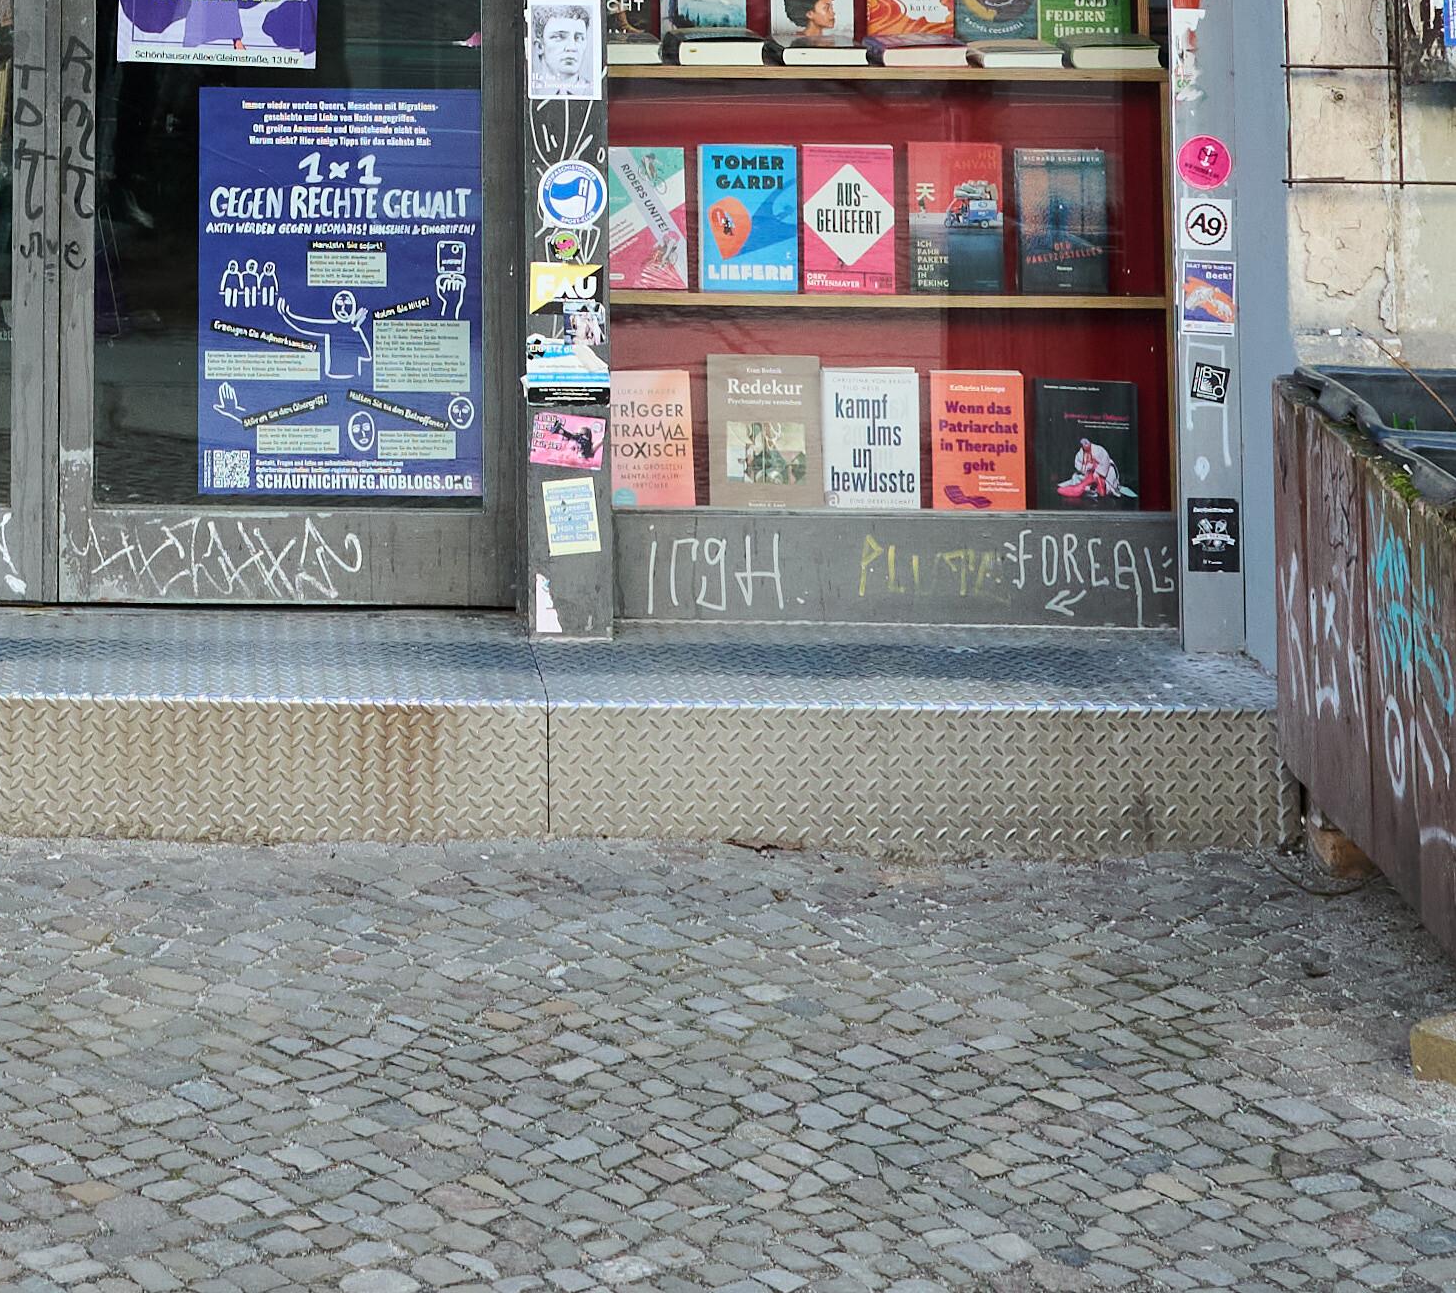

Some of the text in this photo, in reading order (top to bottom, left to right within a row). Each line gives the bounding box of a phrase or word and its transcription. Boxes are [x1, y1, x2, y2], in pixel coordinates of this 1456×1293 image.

[711, 155, 784, 170] TOMER
[716, 173, 784, 191] GARDI
[836, 182, 869, 205] AUS-
[816, 209, 882, 236] GELIEFERT
[535, 273, 597, 300] FAU
[727, 377, 803, 396] Redekur
[945, 401, 1012, 416] Wenn das
[938, 420, 1019, 436] Patriarchat
[940, 439, 1018, 456] in Therapie
[962, 457, 996, 474] geht
